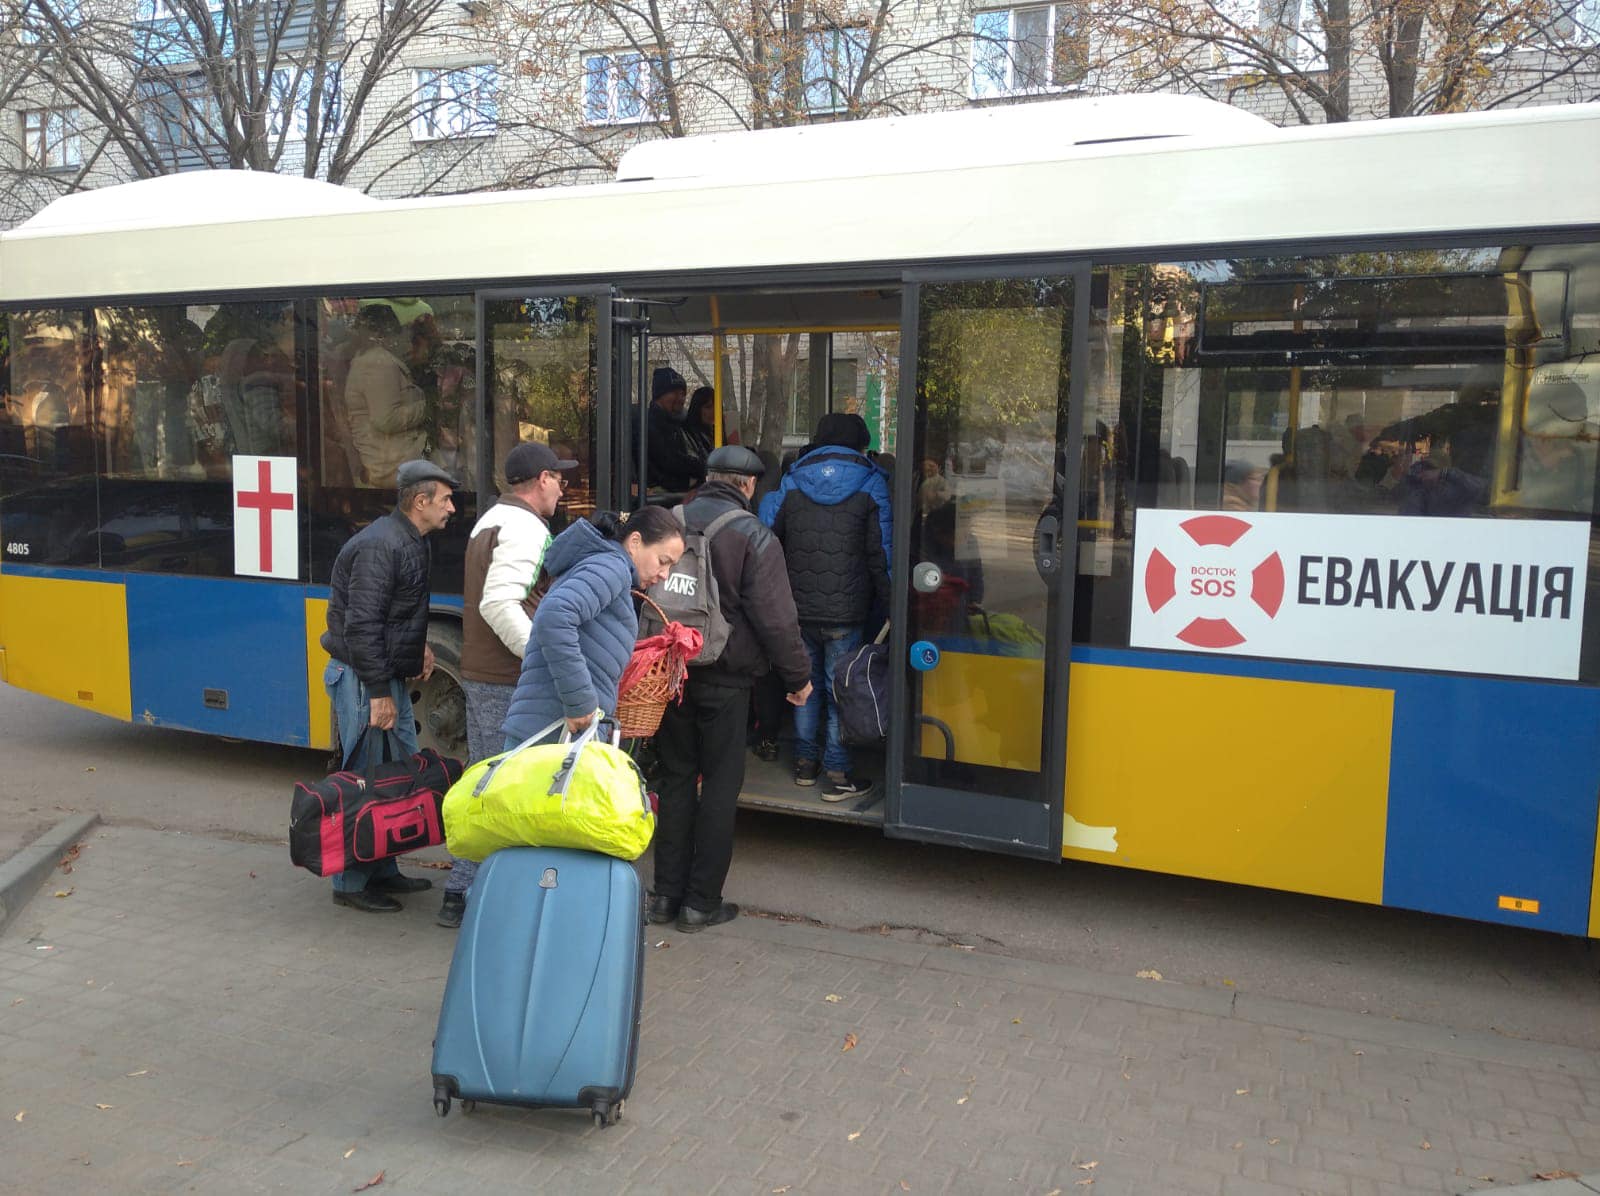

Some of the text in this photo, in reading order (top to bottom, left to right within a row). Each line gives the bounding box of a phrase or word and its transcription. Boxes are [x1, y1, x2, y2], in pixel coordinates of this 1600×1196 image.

[6, 542, 30, 555] 4805
[1191, 566, 1237, 577] ВОСТОК
[664, 573, 698, 597] VANS
[1190, 578, 1236, 598] SOS
[1298, 555, 1574, 622] ЕВАКУАЦІЯ
